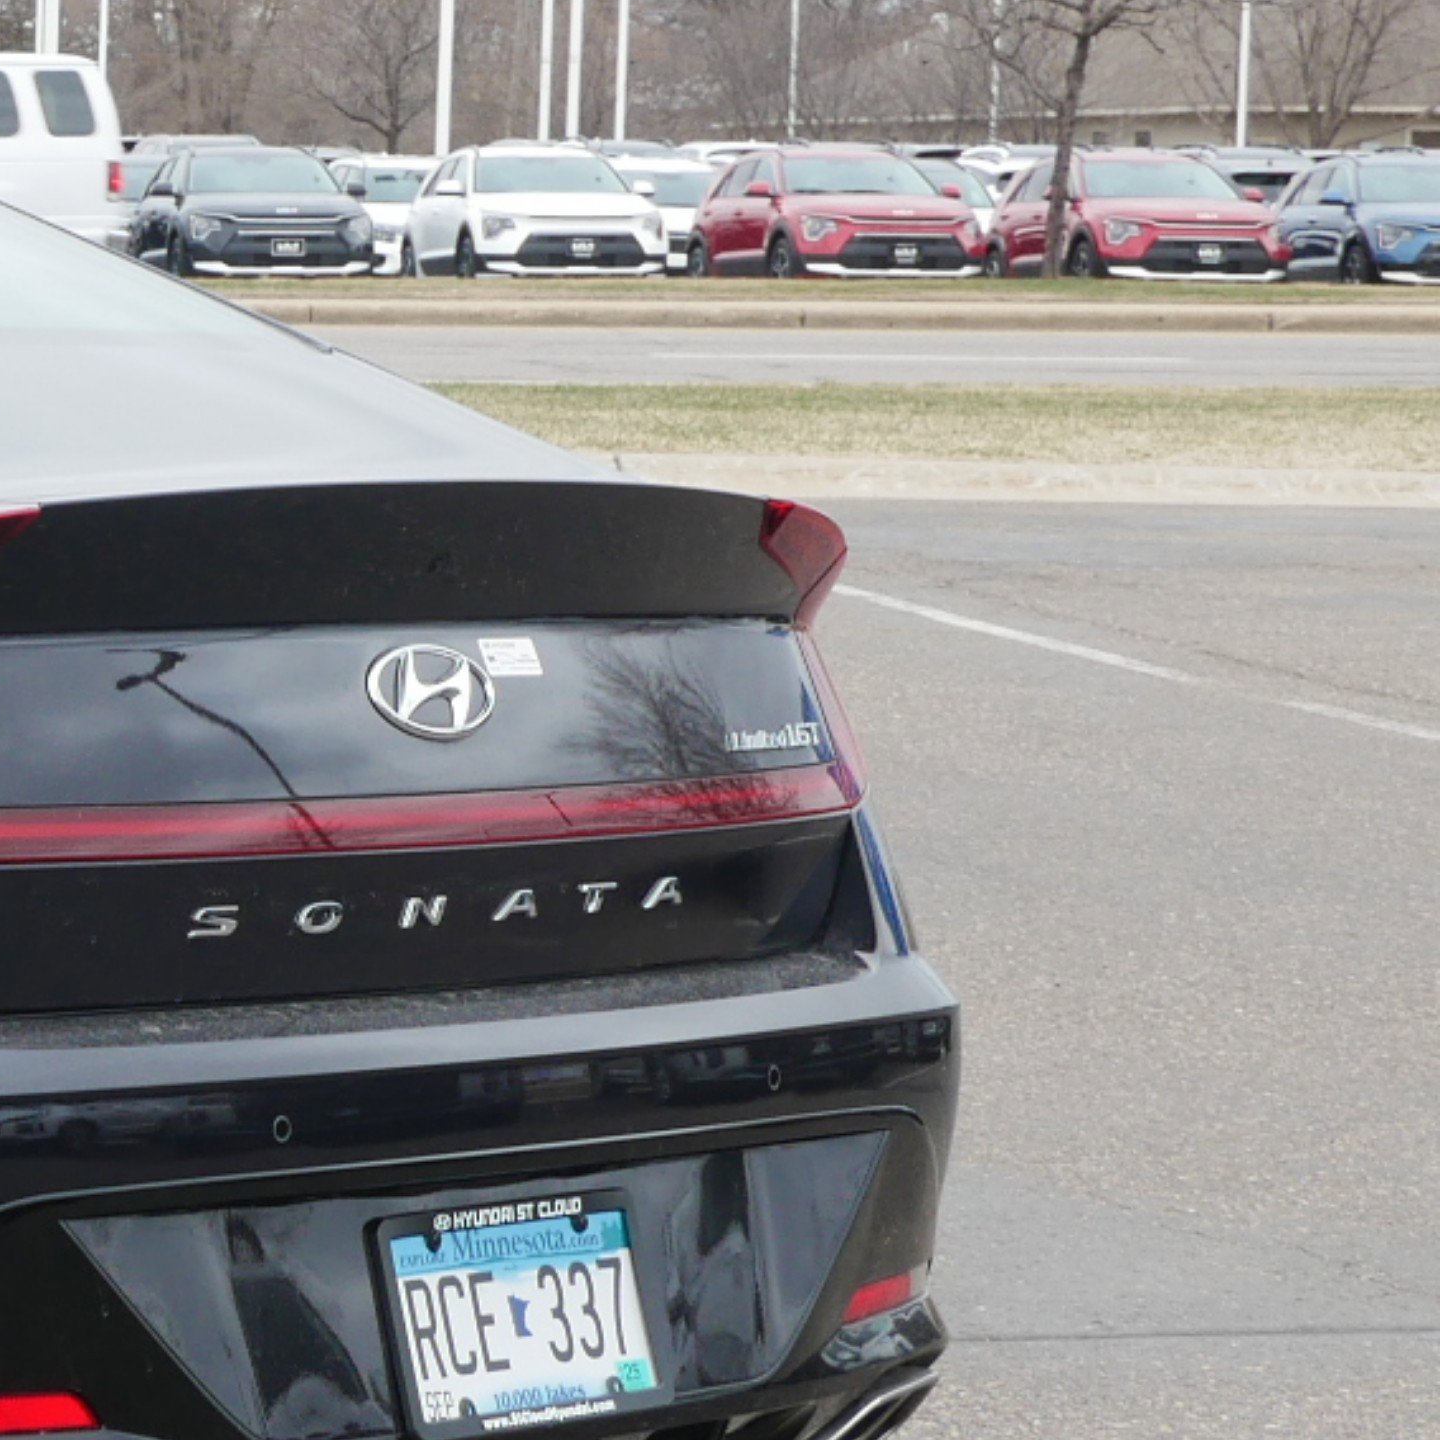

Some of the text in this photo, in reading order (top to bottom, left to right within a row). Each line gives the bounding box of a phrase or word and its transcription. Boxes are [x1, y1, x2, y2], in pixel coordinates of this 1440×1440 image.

[187, 876, 682, 939] SONATA
[452, 1196, 582, 1229] HYUNDAI ST CLOUD
[403, 1257, 627, 1380] RCE 337
